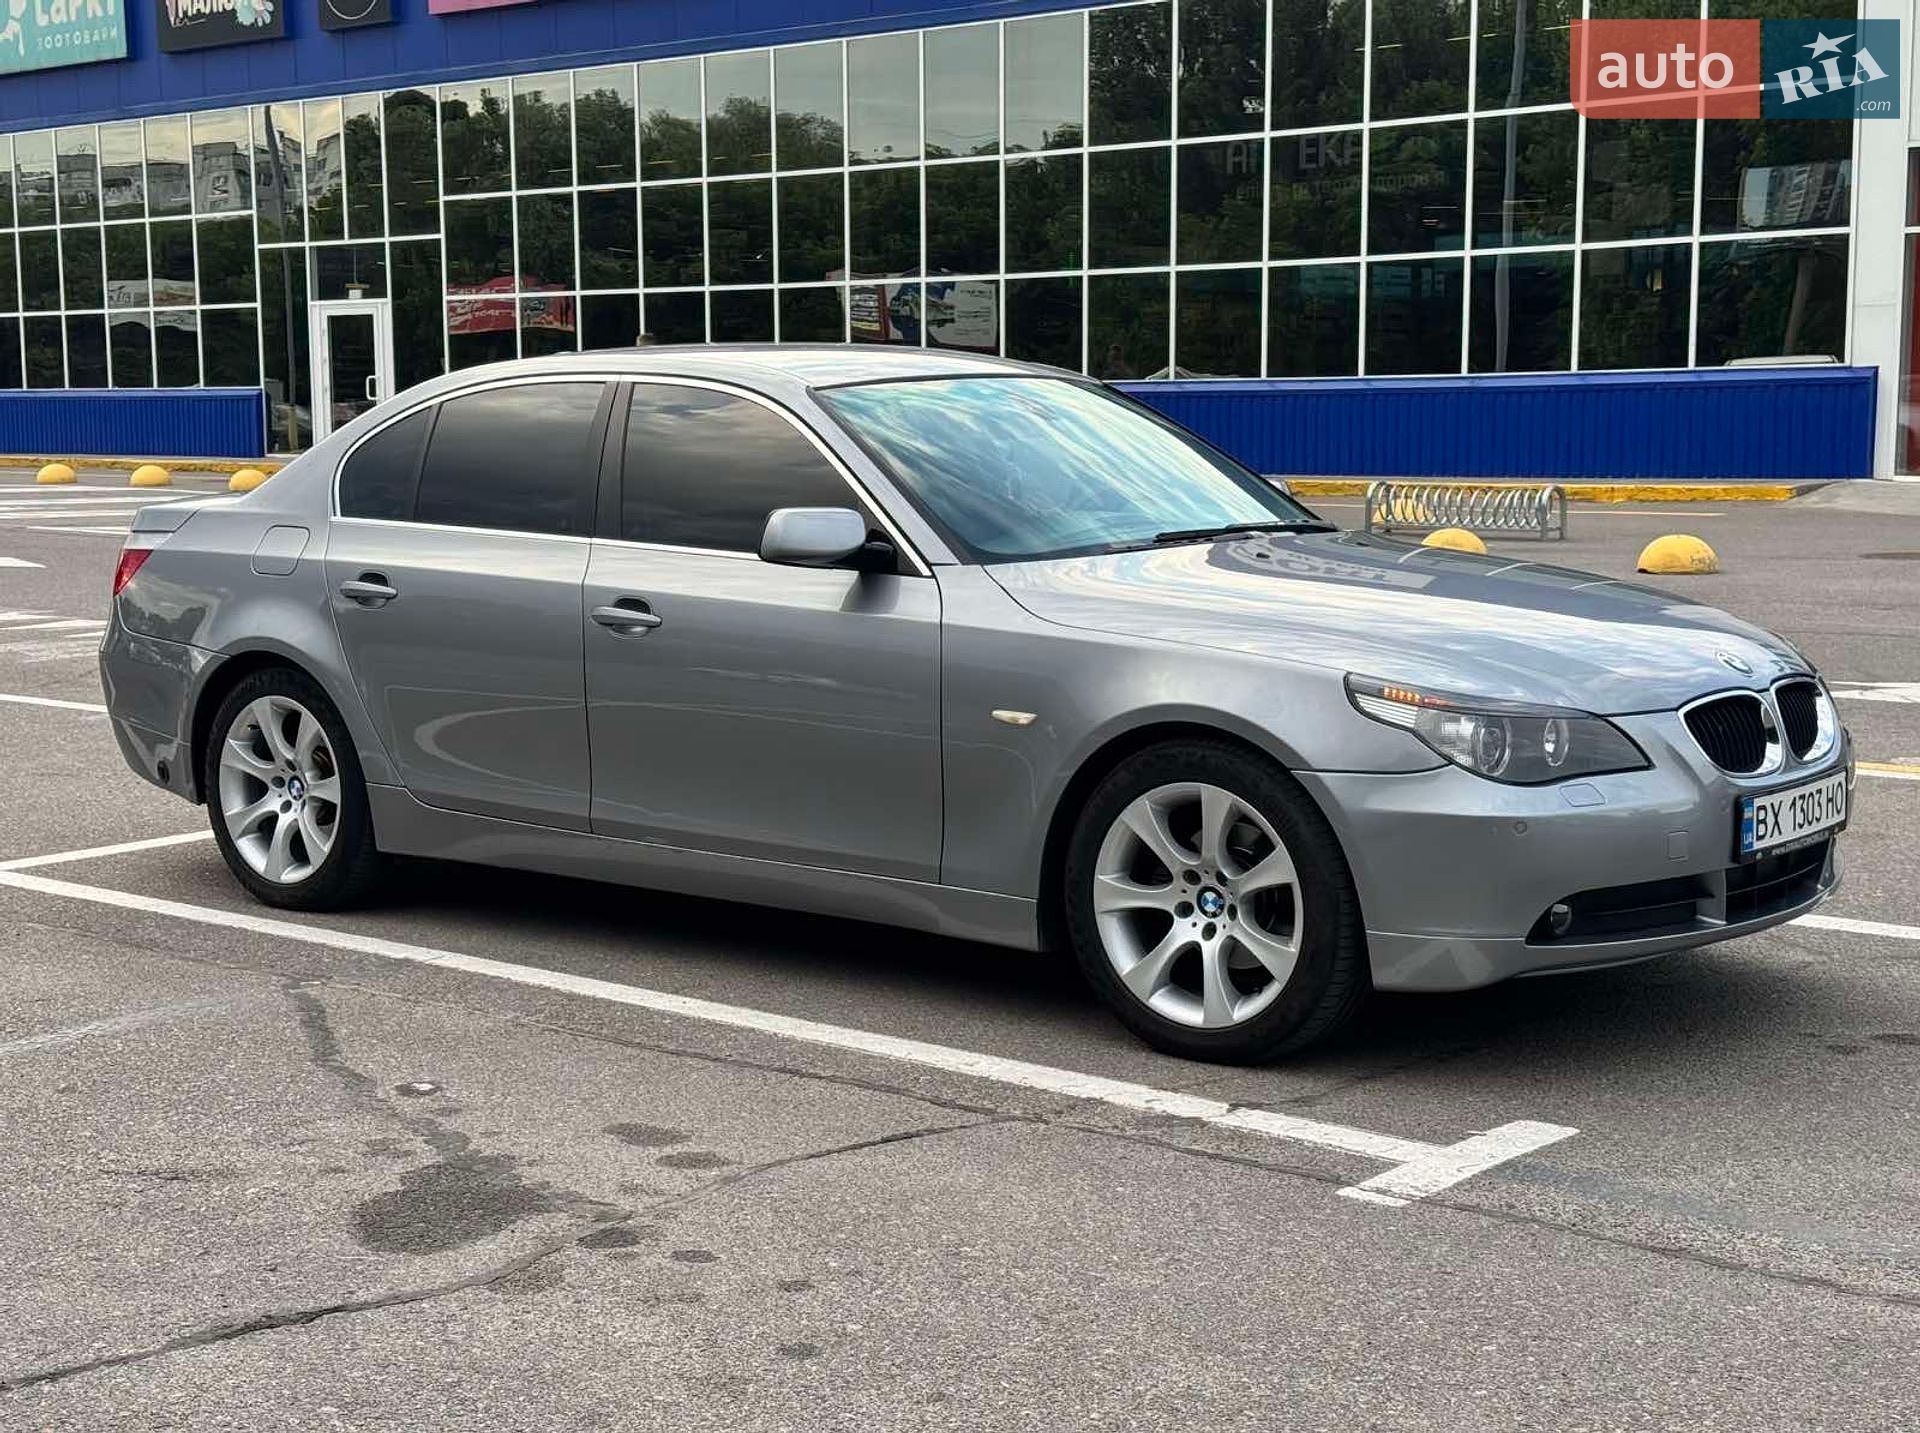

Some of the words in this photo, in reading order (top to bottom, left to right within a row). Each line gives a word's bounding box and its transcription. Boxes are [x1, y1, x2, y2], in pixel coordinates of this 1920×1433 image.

[1755, 800, 1783, 841] BX
[1788, 788, 1823, 831] 1303
[1825, 781, 1844, 821] HO
